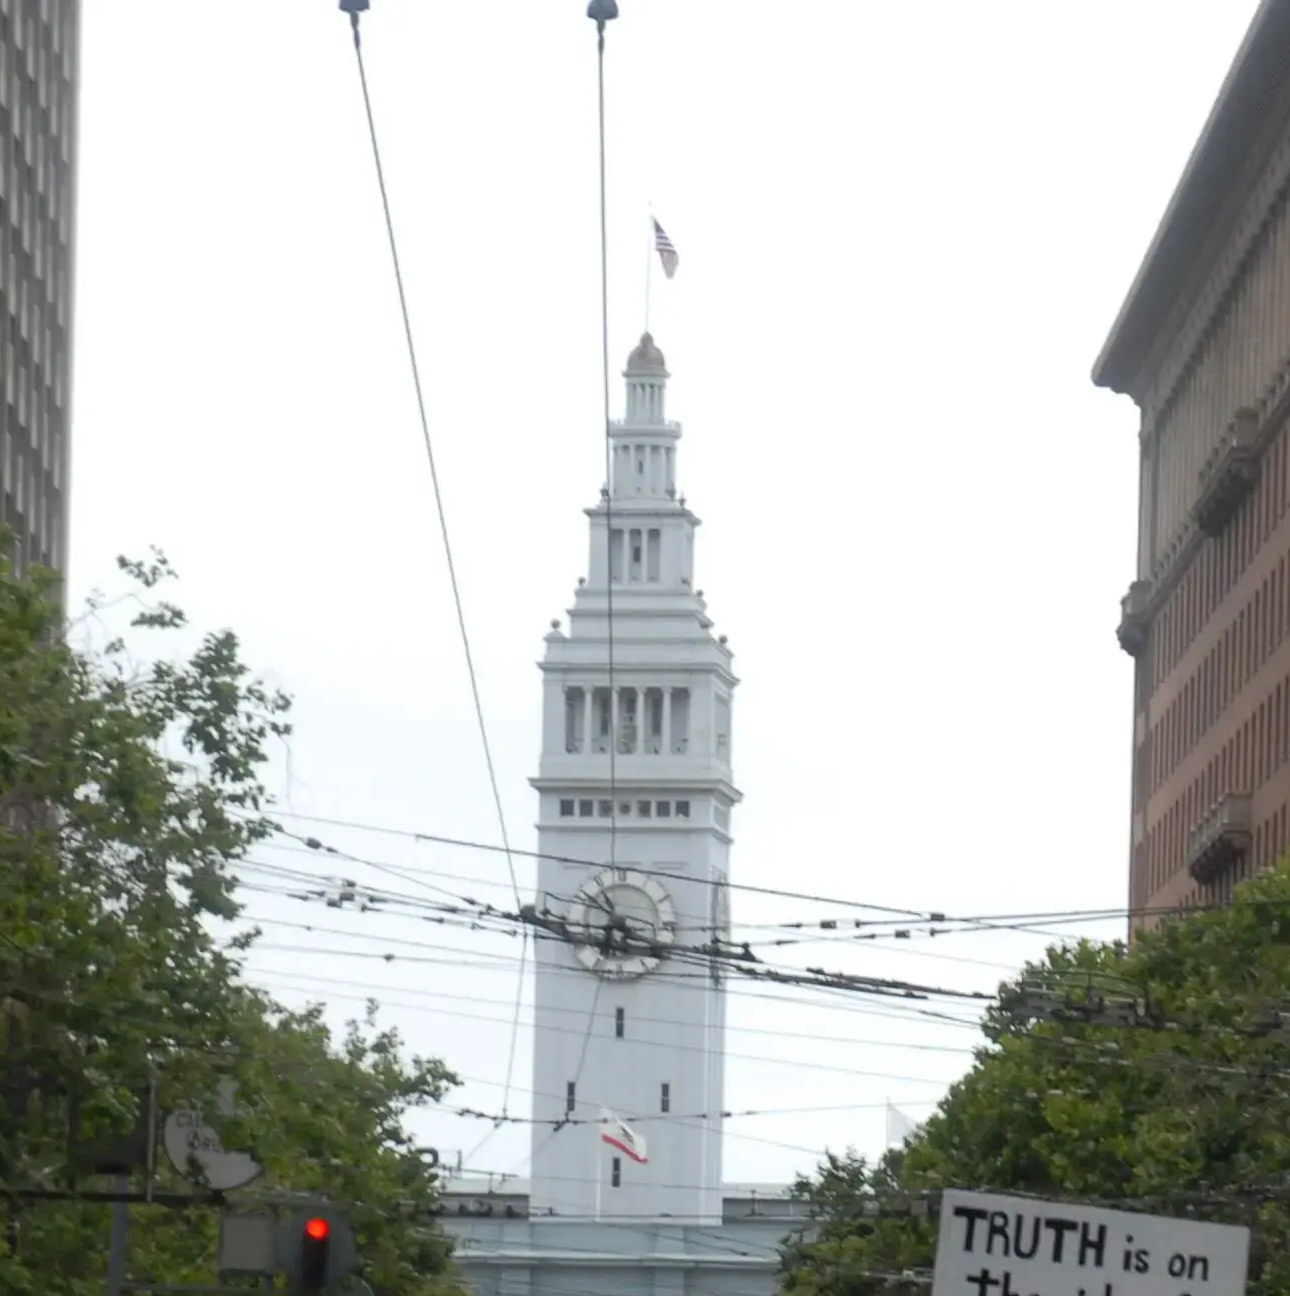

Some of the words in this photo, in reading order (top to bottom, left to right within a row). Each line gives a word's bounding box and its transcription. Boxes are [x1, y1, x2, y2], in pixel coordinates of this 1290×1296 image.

[954, 1206, 1107, 1267] TRUTH
[1122, 1234, 1150, 1274] is
[1167, 1252, 1209, 1281] on
